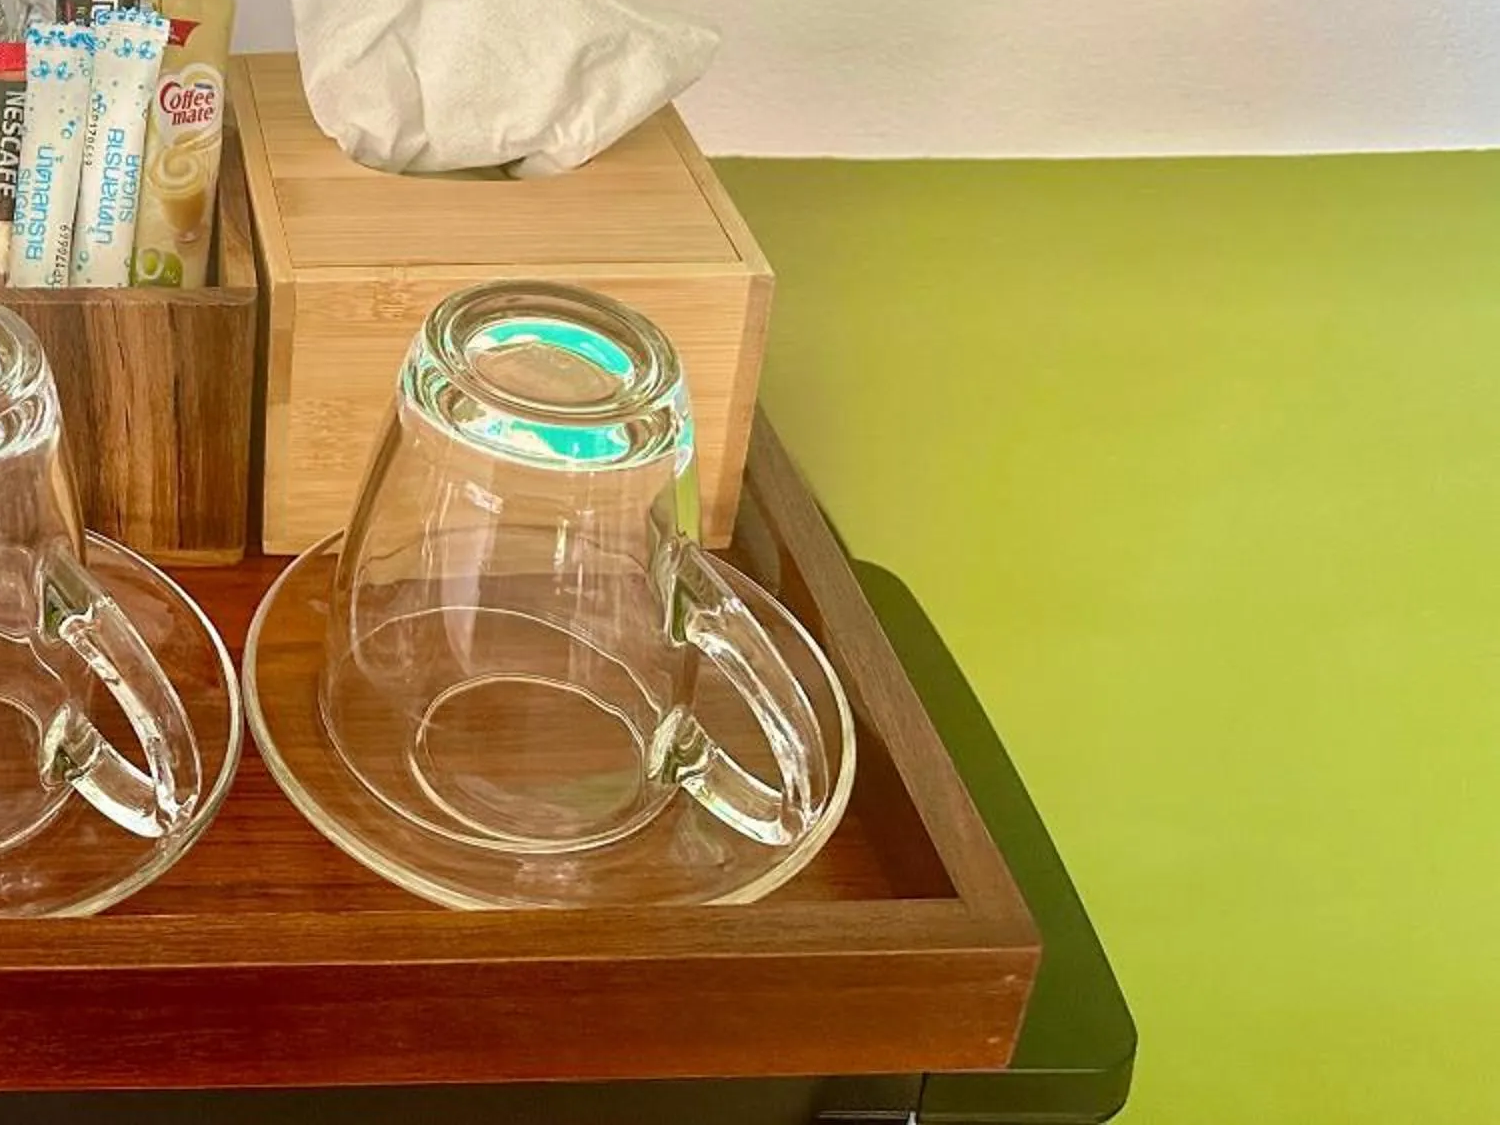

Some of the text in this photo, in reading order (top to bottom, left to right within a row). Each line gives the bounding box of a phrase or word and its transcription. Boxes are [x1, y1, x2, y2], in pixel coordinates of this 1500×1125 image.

[160, 81, 215, 114] Coffee
[172, 106, 214, 126] mate
[14, 167, 31, 237] SUGAR
[118, 154, 141, 223] SUGAR
